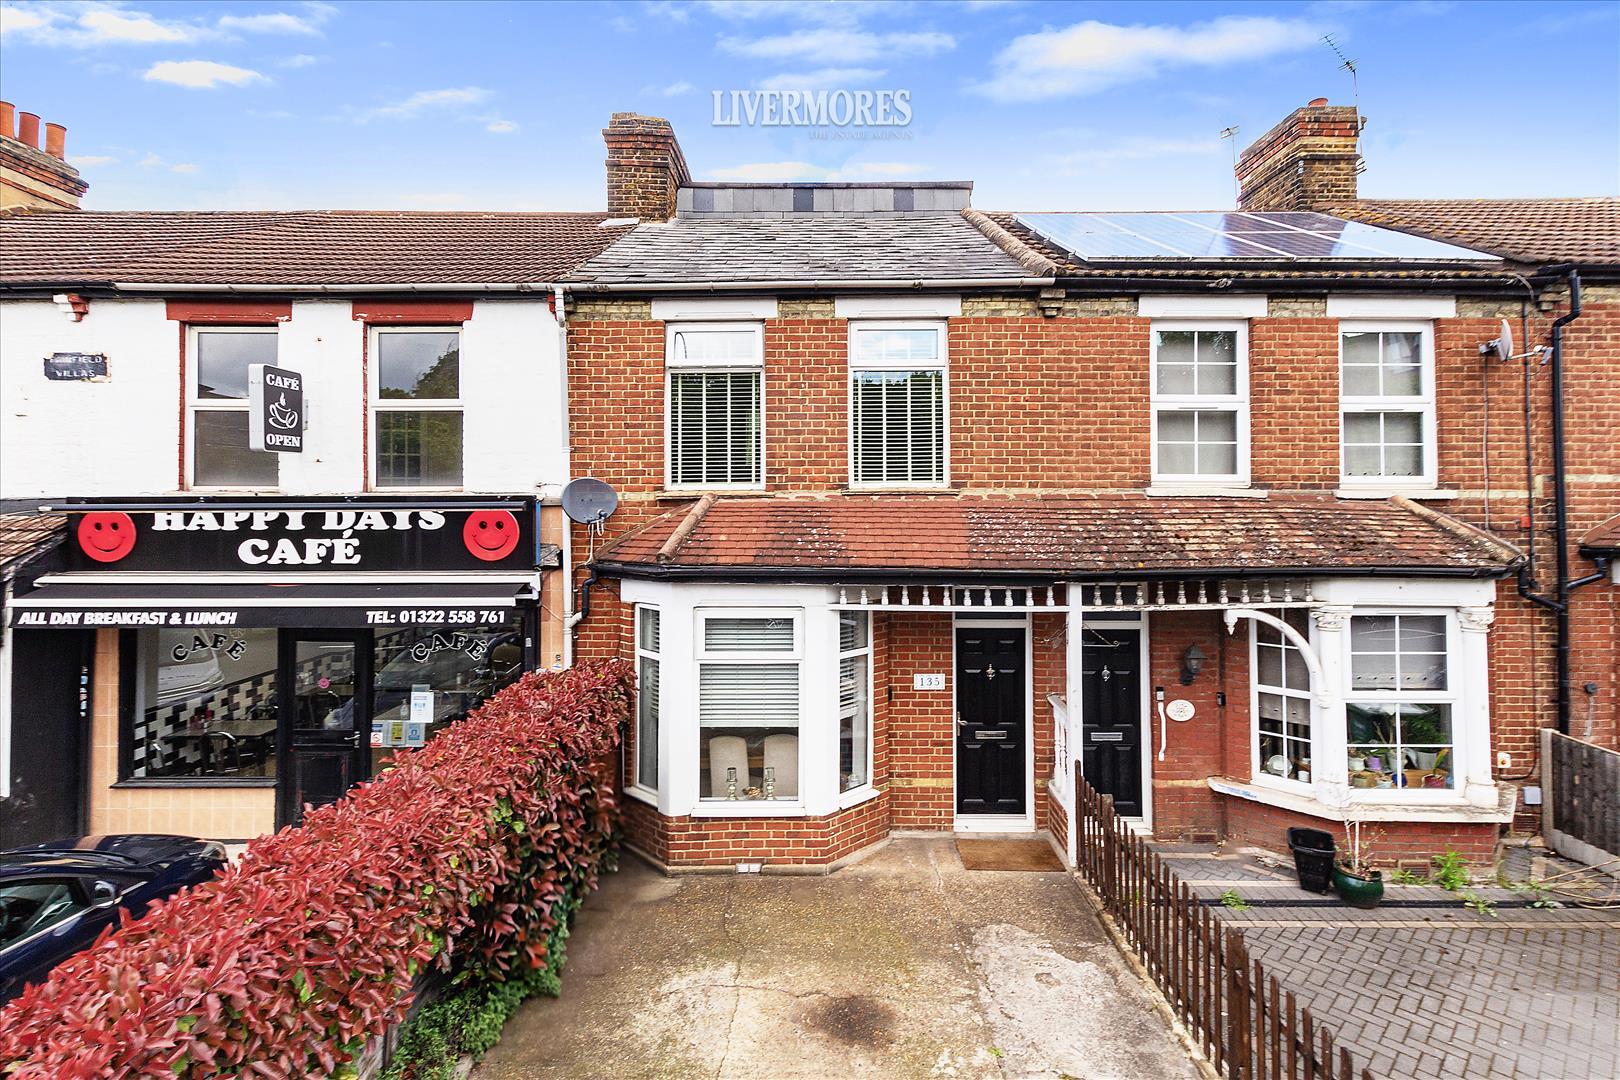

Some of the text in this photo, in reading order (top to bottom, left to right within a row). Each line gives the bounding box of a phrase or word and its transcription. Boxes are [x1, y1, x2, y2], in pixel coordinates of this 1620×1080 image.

[265, 373, 300, 391] CAFÉ
[265, 433, 301, 447] OPEN
[151, 511, 446, 531] HAPPY DAYS
[237, 529, 361, 565] CAFÉ
[18, 611, 238, 625] ALL DAY BREAKFAST & LUNCH
[366, 610, 505, 624] TEL: 01322 558 761
[170, 632, 247, 662] CAFÉ
[411, 632, 488, 662] CAFÉ
[920, 677, 940, 687] 135
